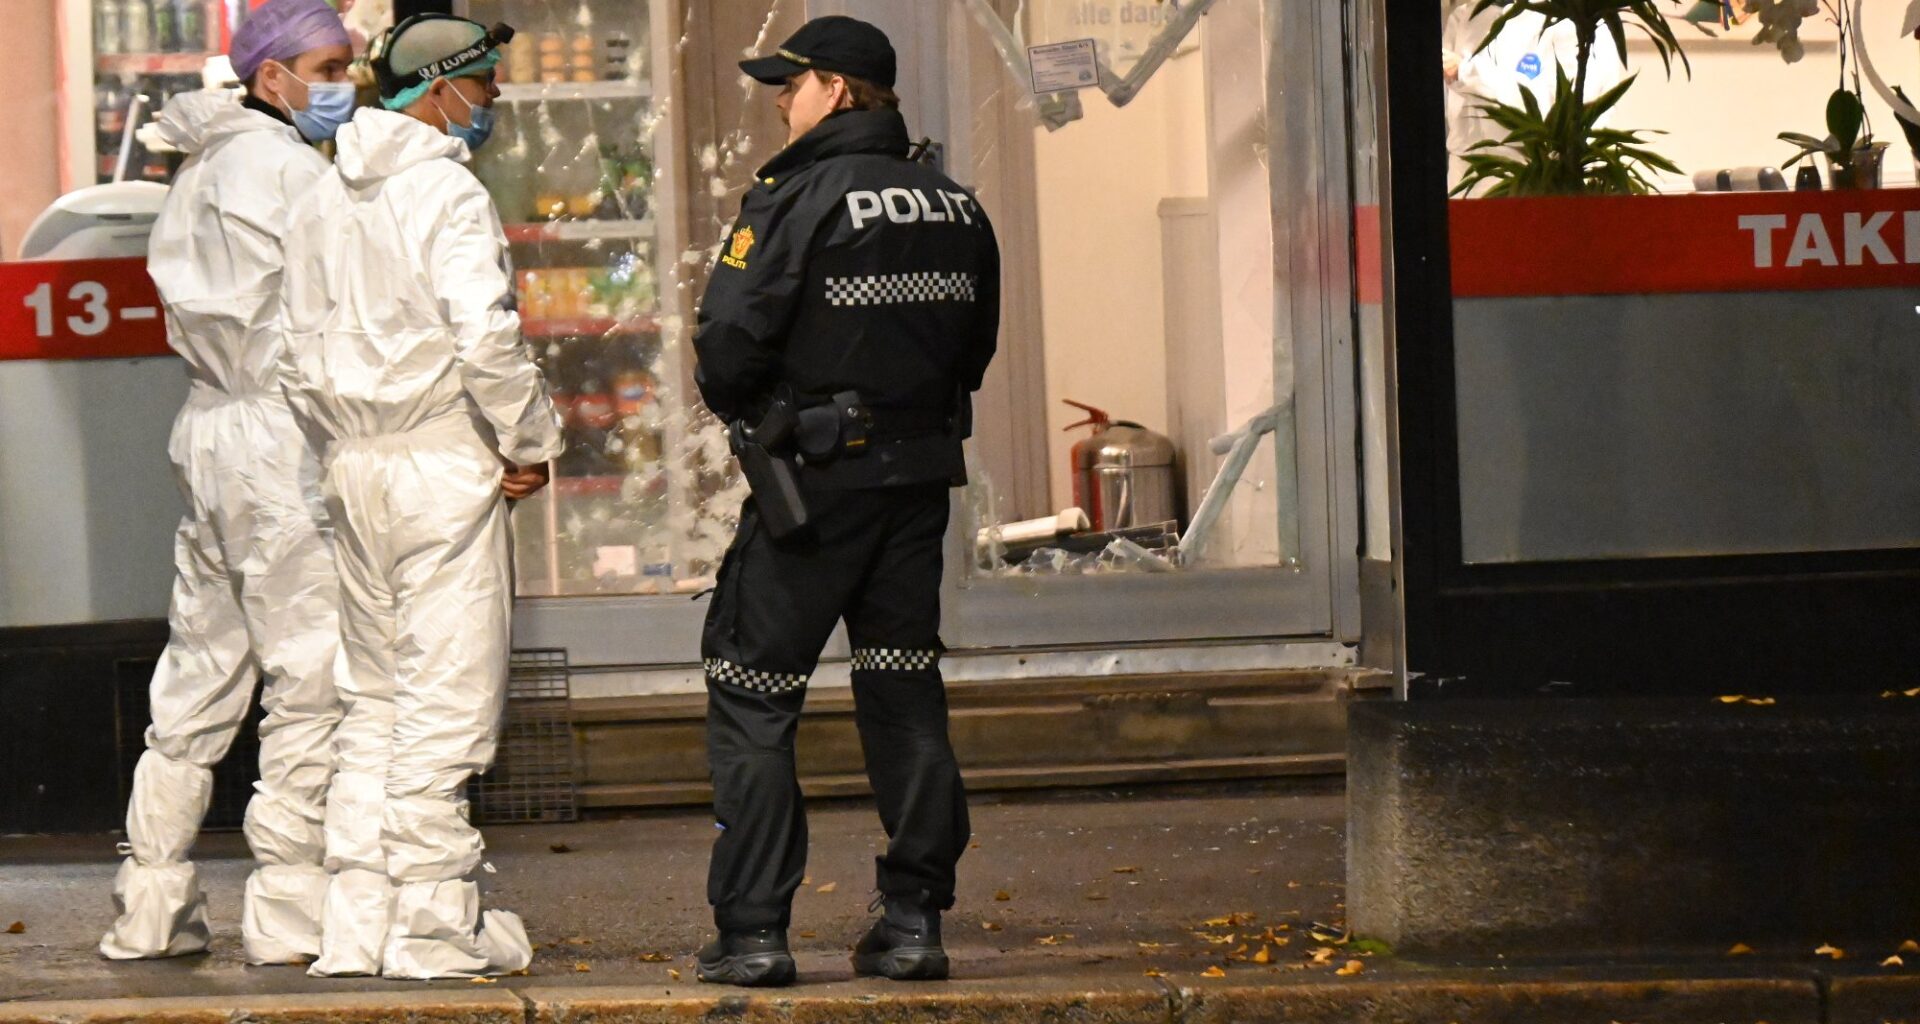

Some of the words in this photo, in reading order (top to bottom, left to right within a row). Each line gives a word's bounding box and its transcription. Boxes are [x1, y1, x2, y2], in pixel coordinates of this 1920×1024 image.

[1120, 0, 1169, 28] dag
[846, 187, 981, 229] POLIT
[722, 255, 746, 269] POLITI
